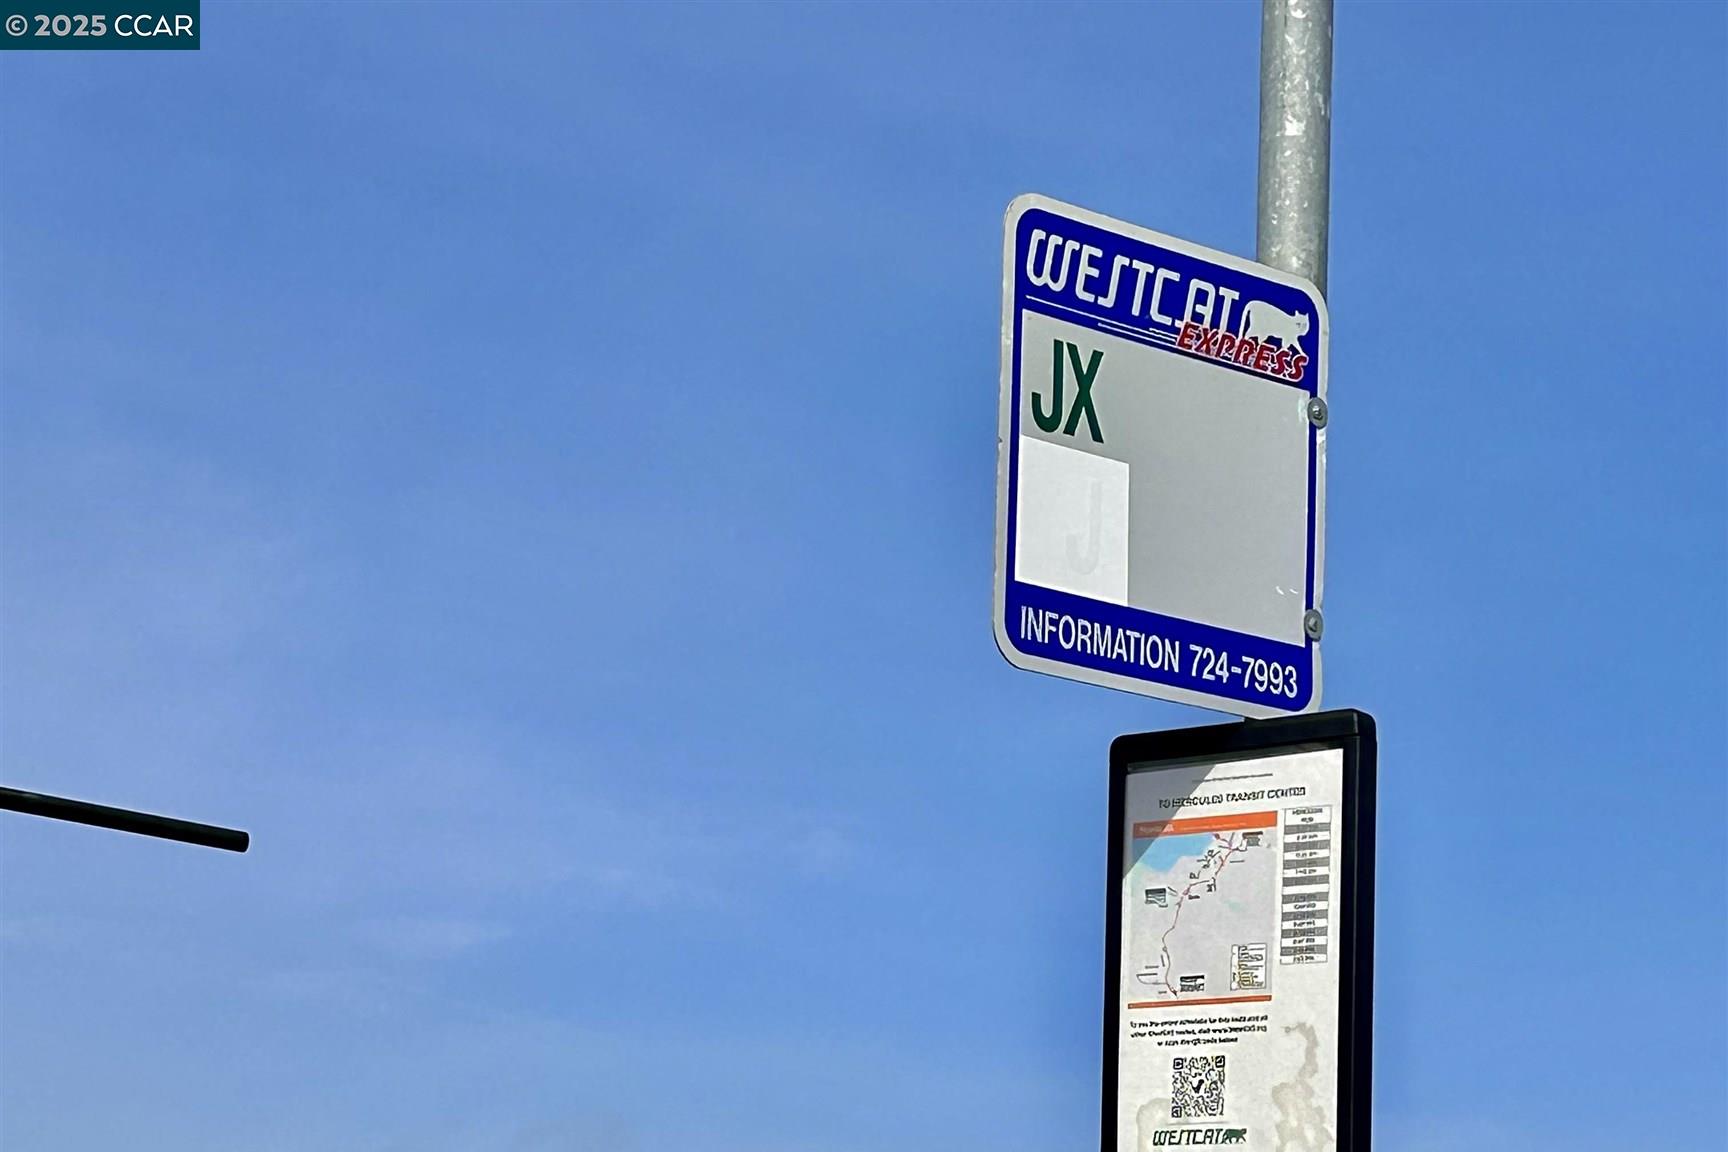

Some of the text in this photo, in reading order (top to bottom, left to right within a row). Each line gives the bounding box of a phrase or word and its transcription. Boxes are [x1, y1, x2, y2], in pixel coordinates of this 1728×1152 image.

[1025, 228, 1240, 330] WESTCAT
[1031, 338, 1105, 445] JX
[1177, 320, 1309, 381] EXPRESS
[1019, 605, 1298, 699] INFORMATION 724-7993
[1152, 1128, 1225, 1146] WESTCAT
